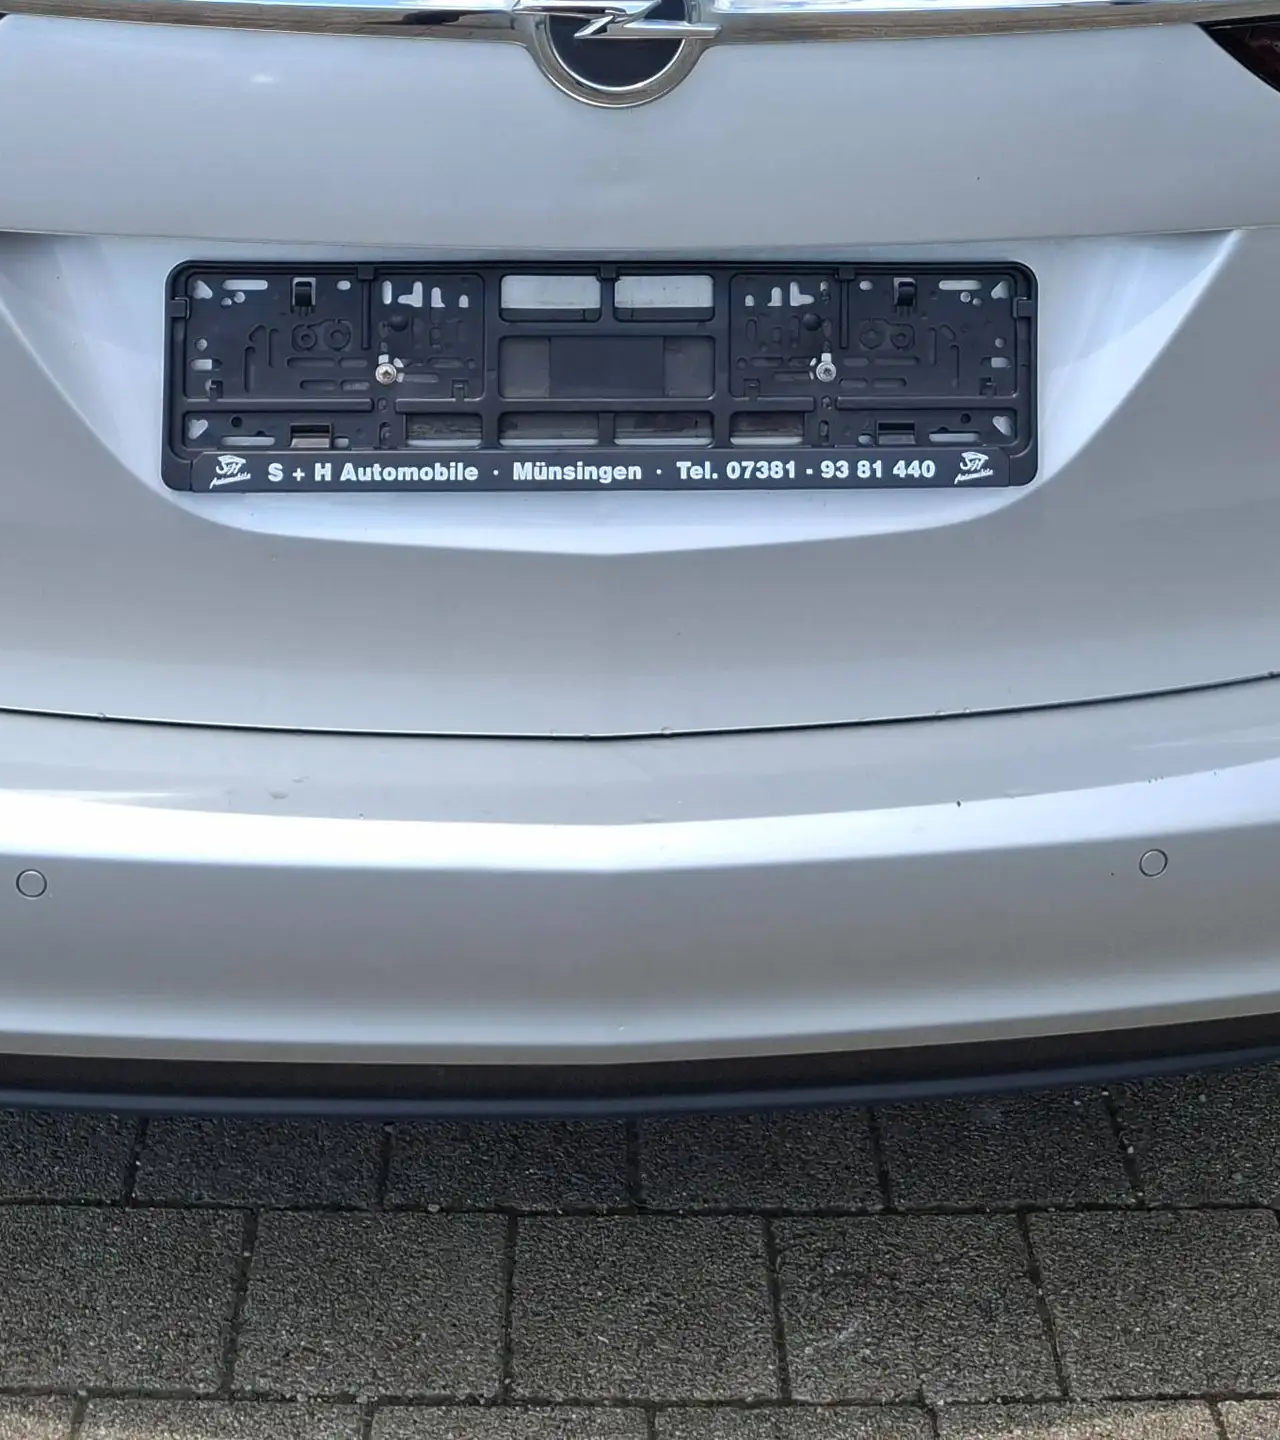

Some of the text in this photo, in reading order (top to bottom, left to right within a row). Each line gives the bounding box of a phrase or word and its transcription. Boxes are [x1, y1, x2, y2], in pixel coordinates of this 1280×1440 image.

[267, 462, 284, 482] S
[292, 468, 305, 481] +
[315, 462, 332, 481] H
[339, 462, 479, 481] Automobile
[513, 461, 642, 484] Münsingen
[676, 461, 719, 480] Tel.
[726, 460, 796, 479] 07381
[820, 460, 849, 478] 93
[857, 460, 883, 478] 81
[893, 460, 935, 478] 440
